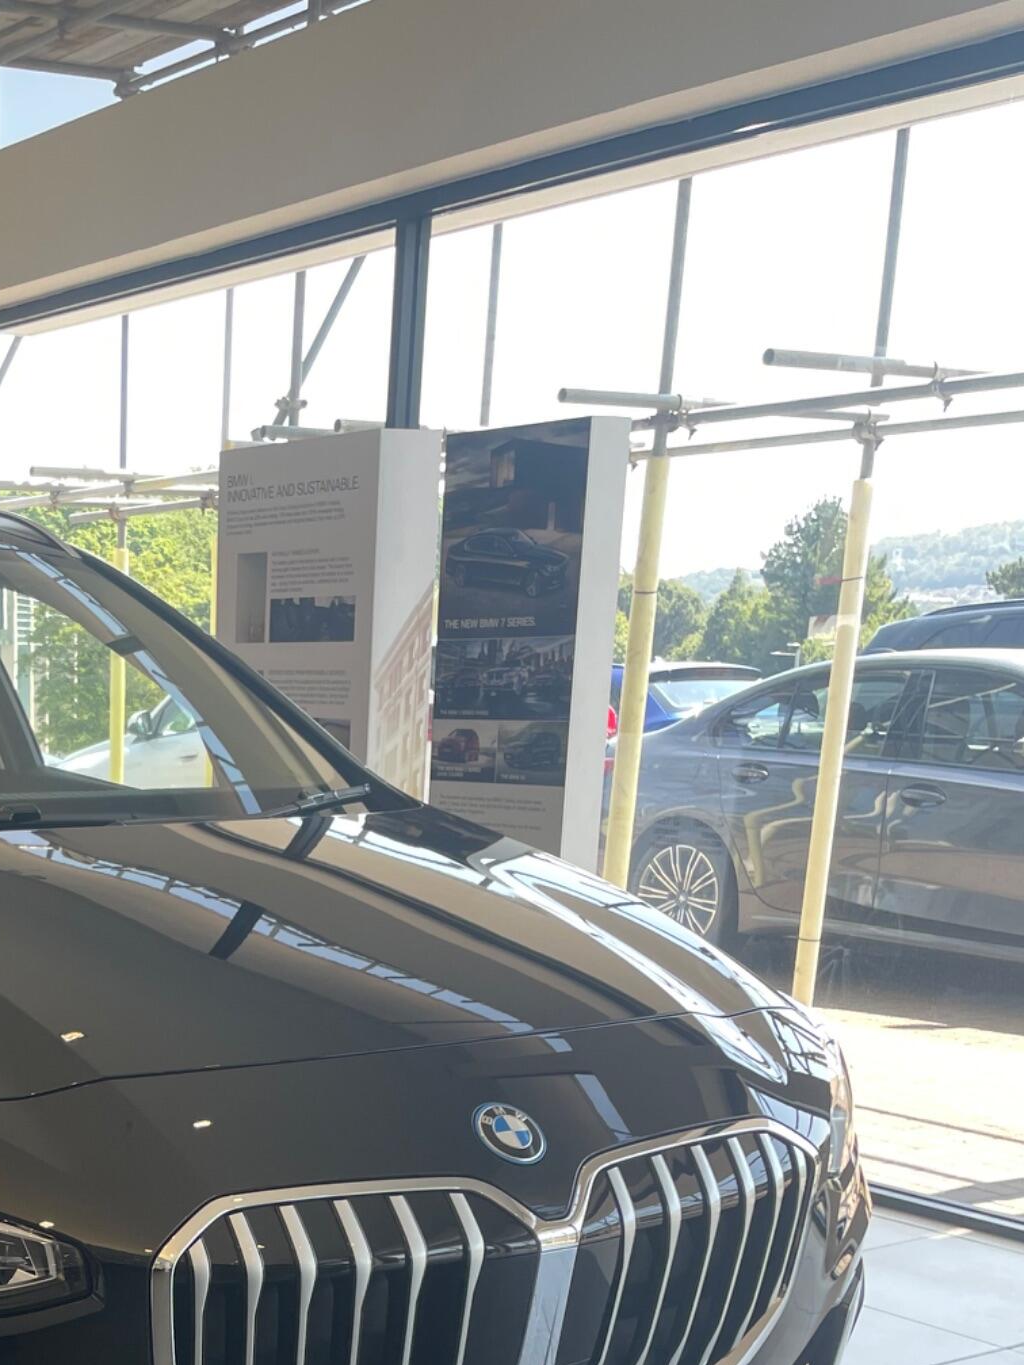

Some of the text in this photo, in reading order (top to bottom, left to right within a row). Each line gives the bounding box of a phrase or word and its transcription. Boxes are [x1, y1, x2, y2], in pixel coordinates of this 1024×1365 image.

[227, 473, 249, 488] BMW
[227, 475, 360, 503] INNOVATIVE AND SUSTAINABLE
[444, 619, 460, 629] THE
[460, 618, 478, 629] NEW
[479, 618, 499, 628] BMW
